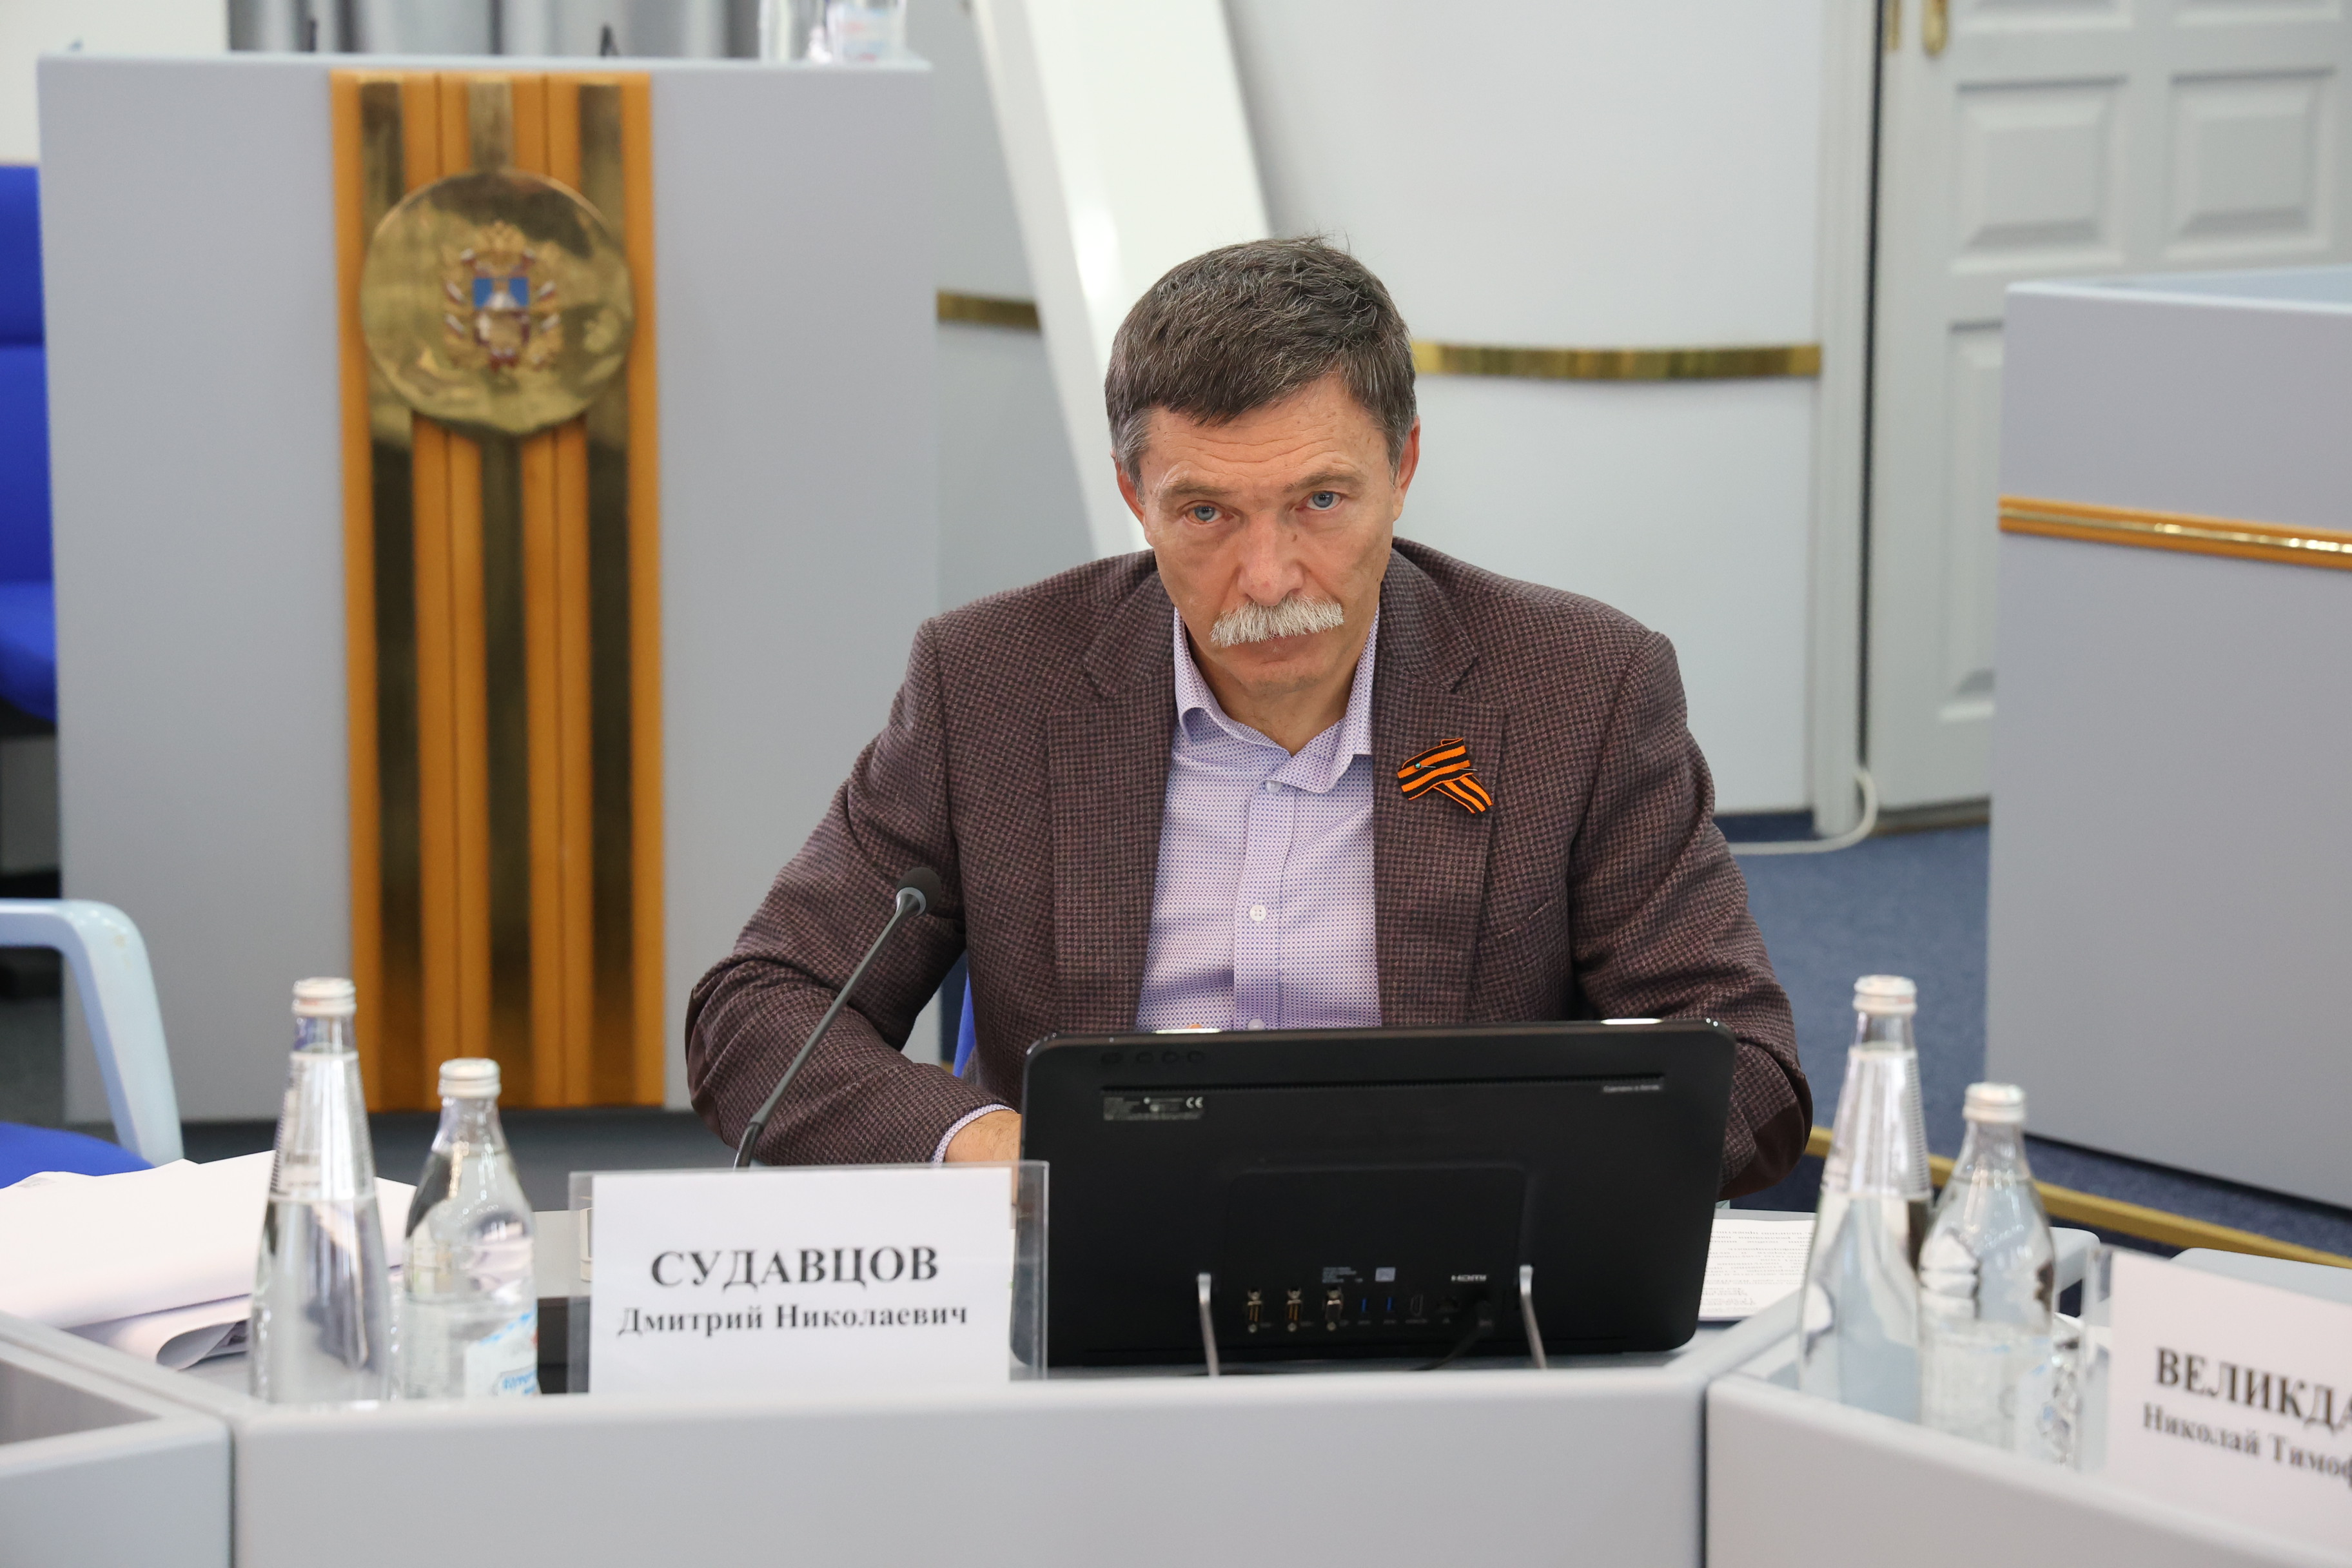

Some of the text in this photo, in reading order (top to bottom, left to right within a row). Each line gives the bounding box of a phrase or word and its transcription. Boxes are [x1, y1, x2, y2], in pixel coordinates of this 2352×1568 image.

[651, 1246, 939, 1291] СУДАВЦОВ
[618, 1304, 968, 1337] Дмитрий Николаевич
[2143, 1400, 2260, 1456] Николай
